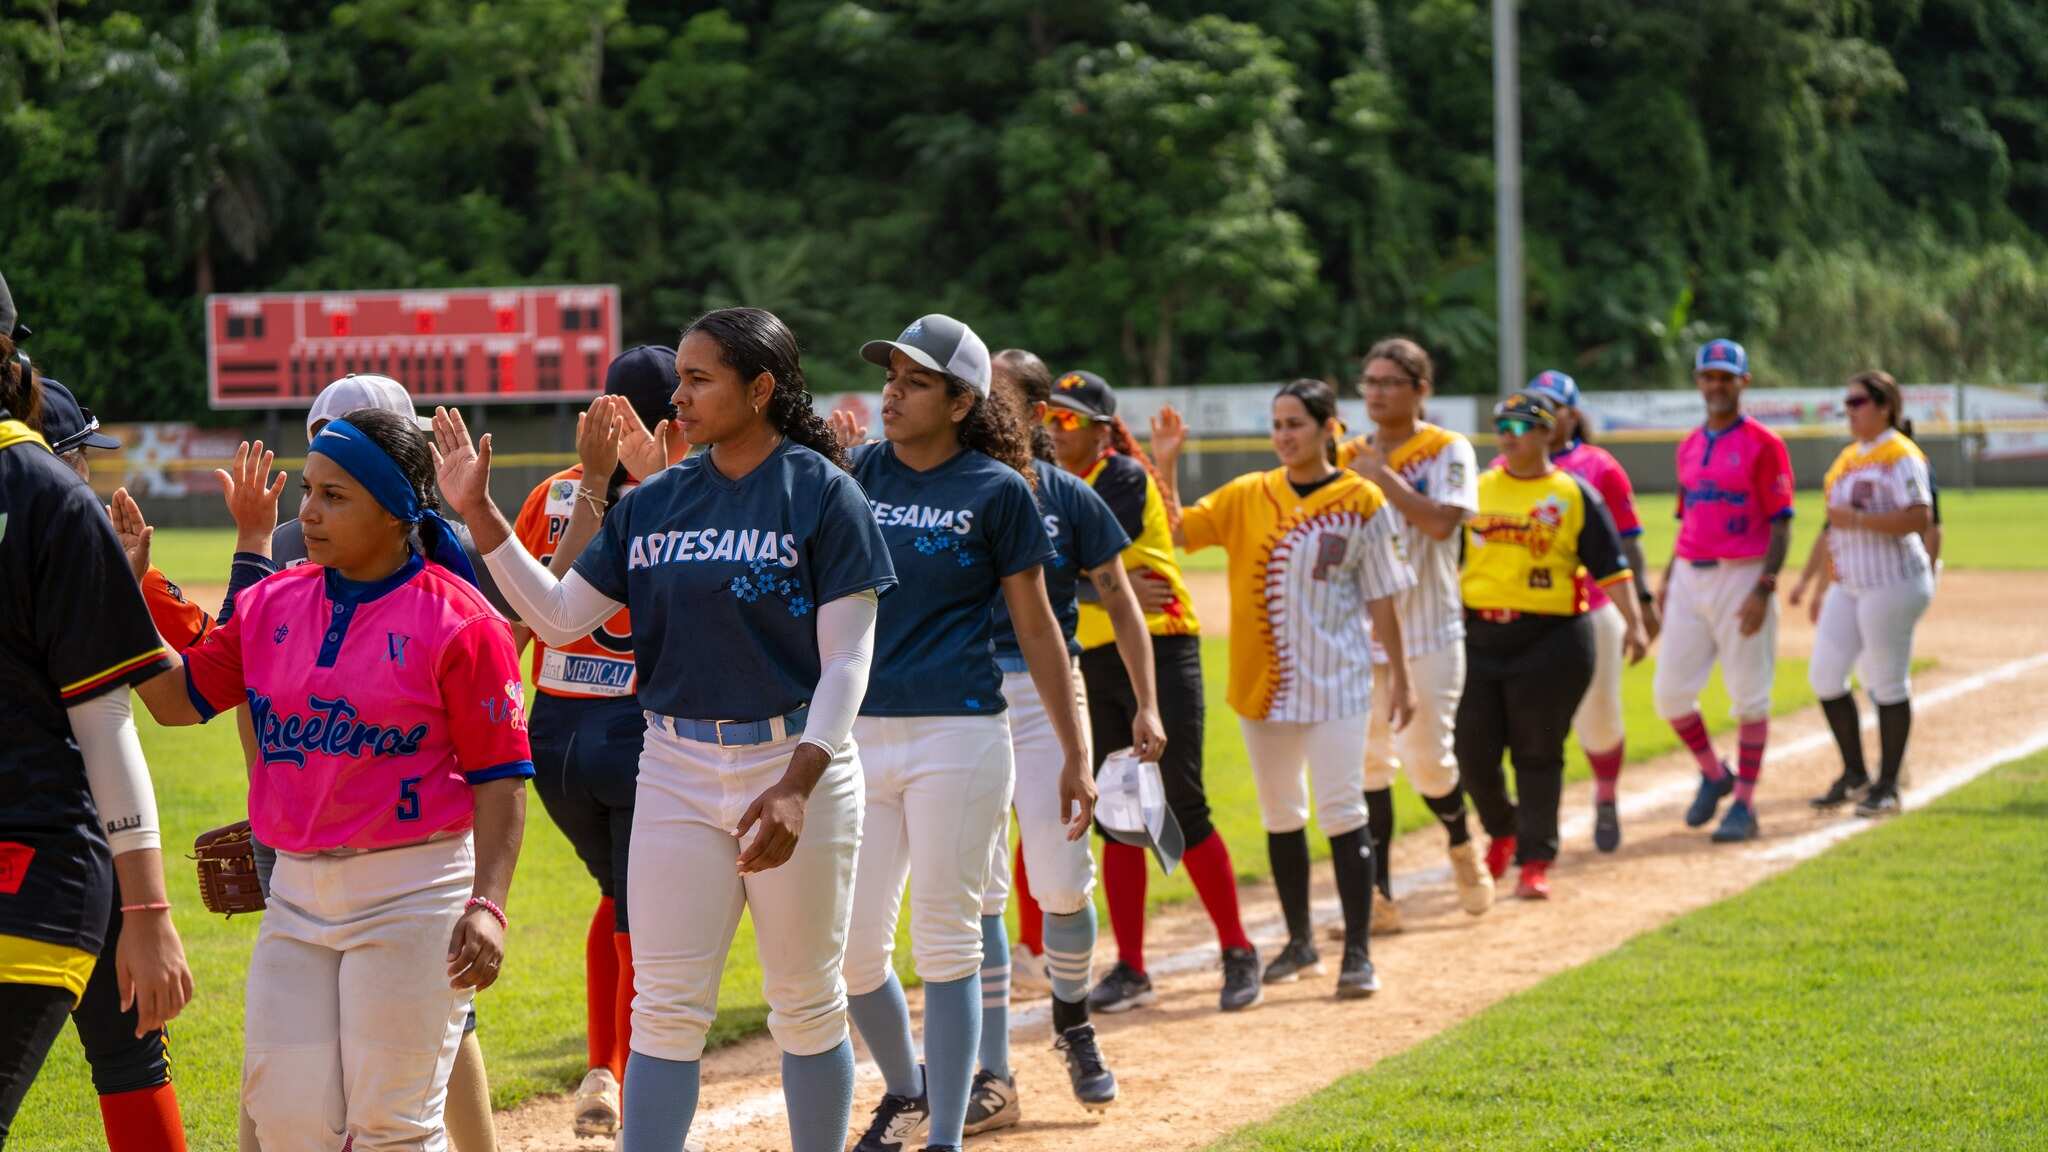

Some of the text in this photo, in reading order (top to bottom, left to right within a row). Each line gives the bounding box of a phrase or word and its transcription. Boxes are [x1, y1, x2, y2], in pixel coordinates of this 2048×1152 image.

[870, 500, 974, 535] ESANAS
[628, 528, 799, 570] ARTESANAS
[564, 659, 629, 686] MEDICAL
[396, 776, 422, 822] 5
